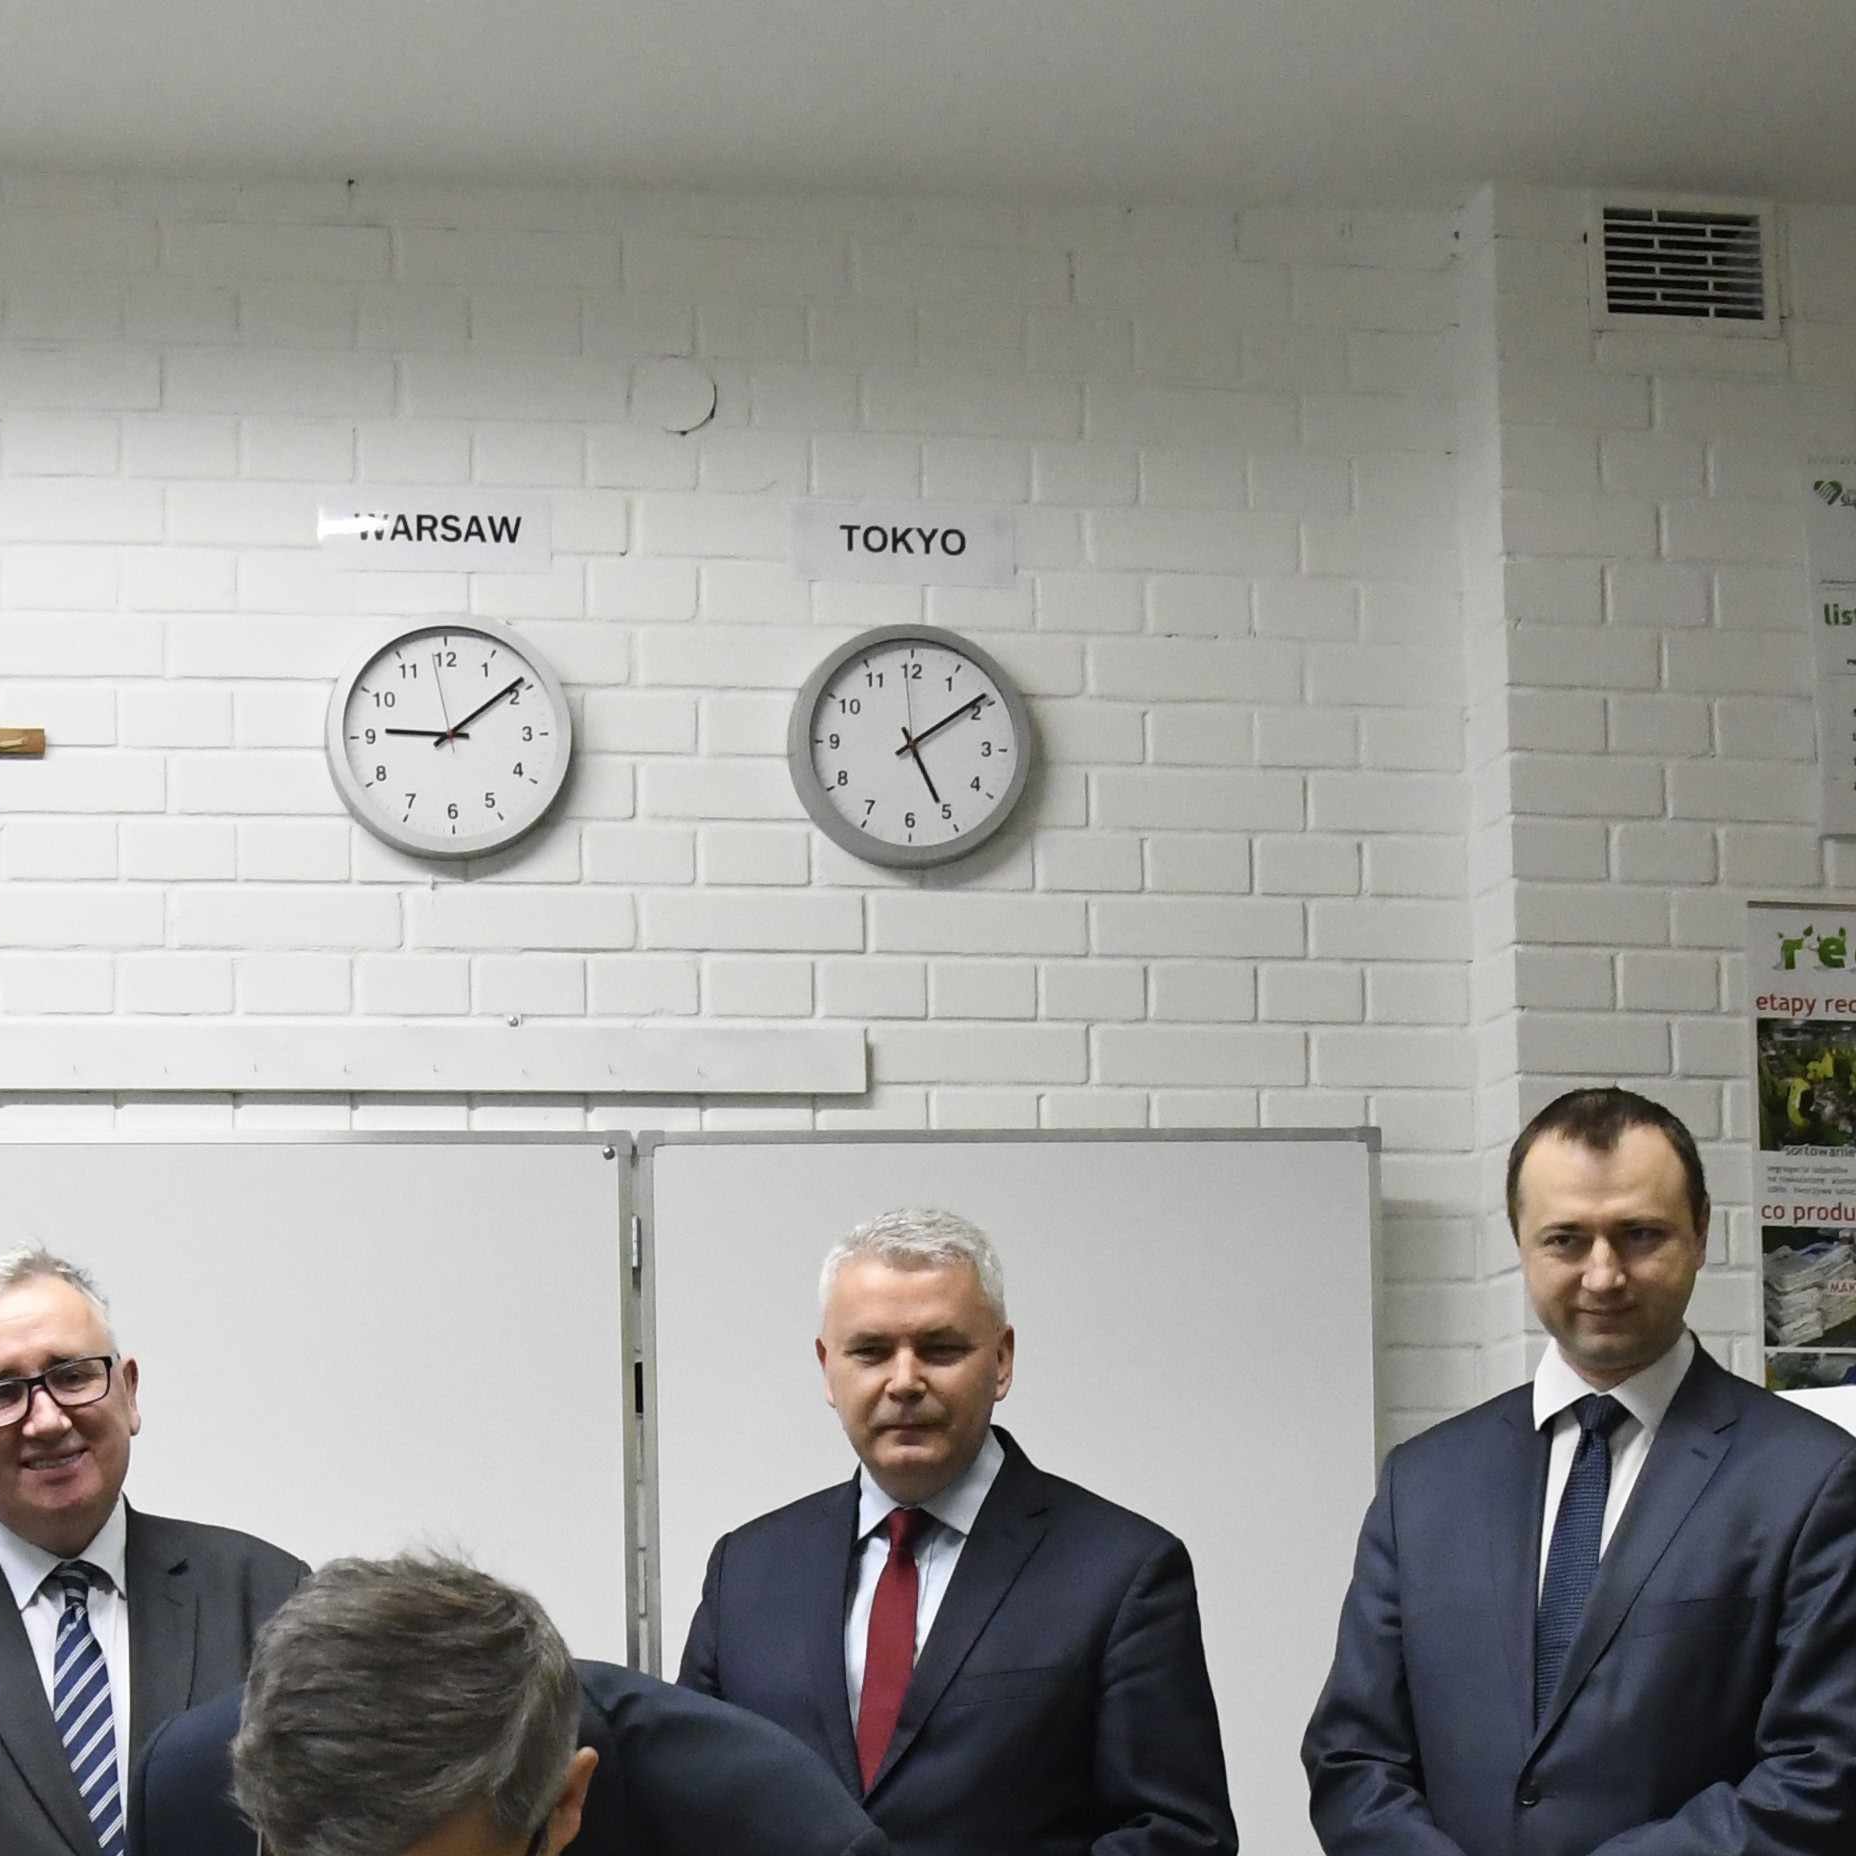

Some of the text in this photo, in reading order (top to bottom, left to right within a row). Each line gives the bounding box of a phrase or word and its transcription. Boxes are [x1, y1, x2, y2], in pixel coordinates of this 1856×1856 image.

[840, 524, 967, 556] TOKYO
[435, 652, 457, 667] 12
[399, 664, 416, 678] 11
[482, 663, 488, 677] 1
[901, 664, 922, 680] 12
[866, 673, 884, 687] 11
[945, 677, 952, 692] 1
[373, 691, 395, 707] 10
[839, 699, 860, 714] 10
[365, 729, 376, 744] 9
[522, 726, 532, 742] 3
[830, 734, 840, 750] 9
[981, 742, 991, 757] 3
[376, 766, 386, 781] 8
[513, 763, 523, 777] 4
[838, 771, 848, 786] 8
[970, 776, 980, 792] 4
[405, 793, 416, 809] 7
[485, 793, 495, 808] 5
[865, 800, 875, 815] 7
[448, 803, 458, 819] 6
[942, 804, 952, 819] 5
[905, 813, 915, 828] 6
[1756, 993, 1816, 1016] etapy
[1761, 1204, 1785, 1220] co
